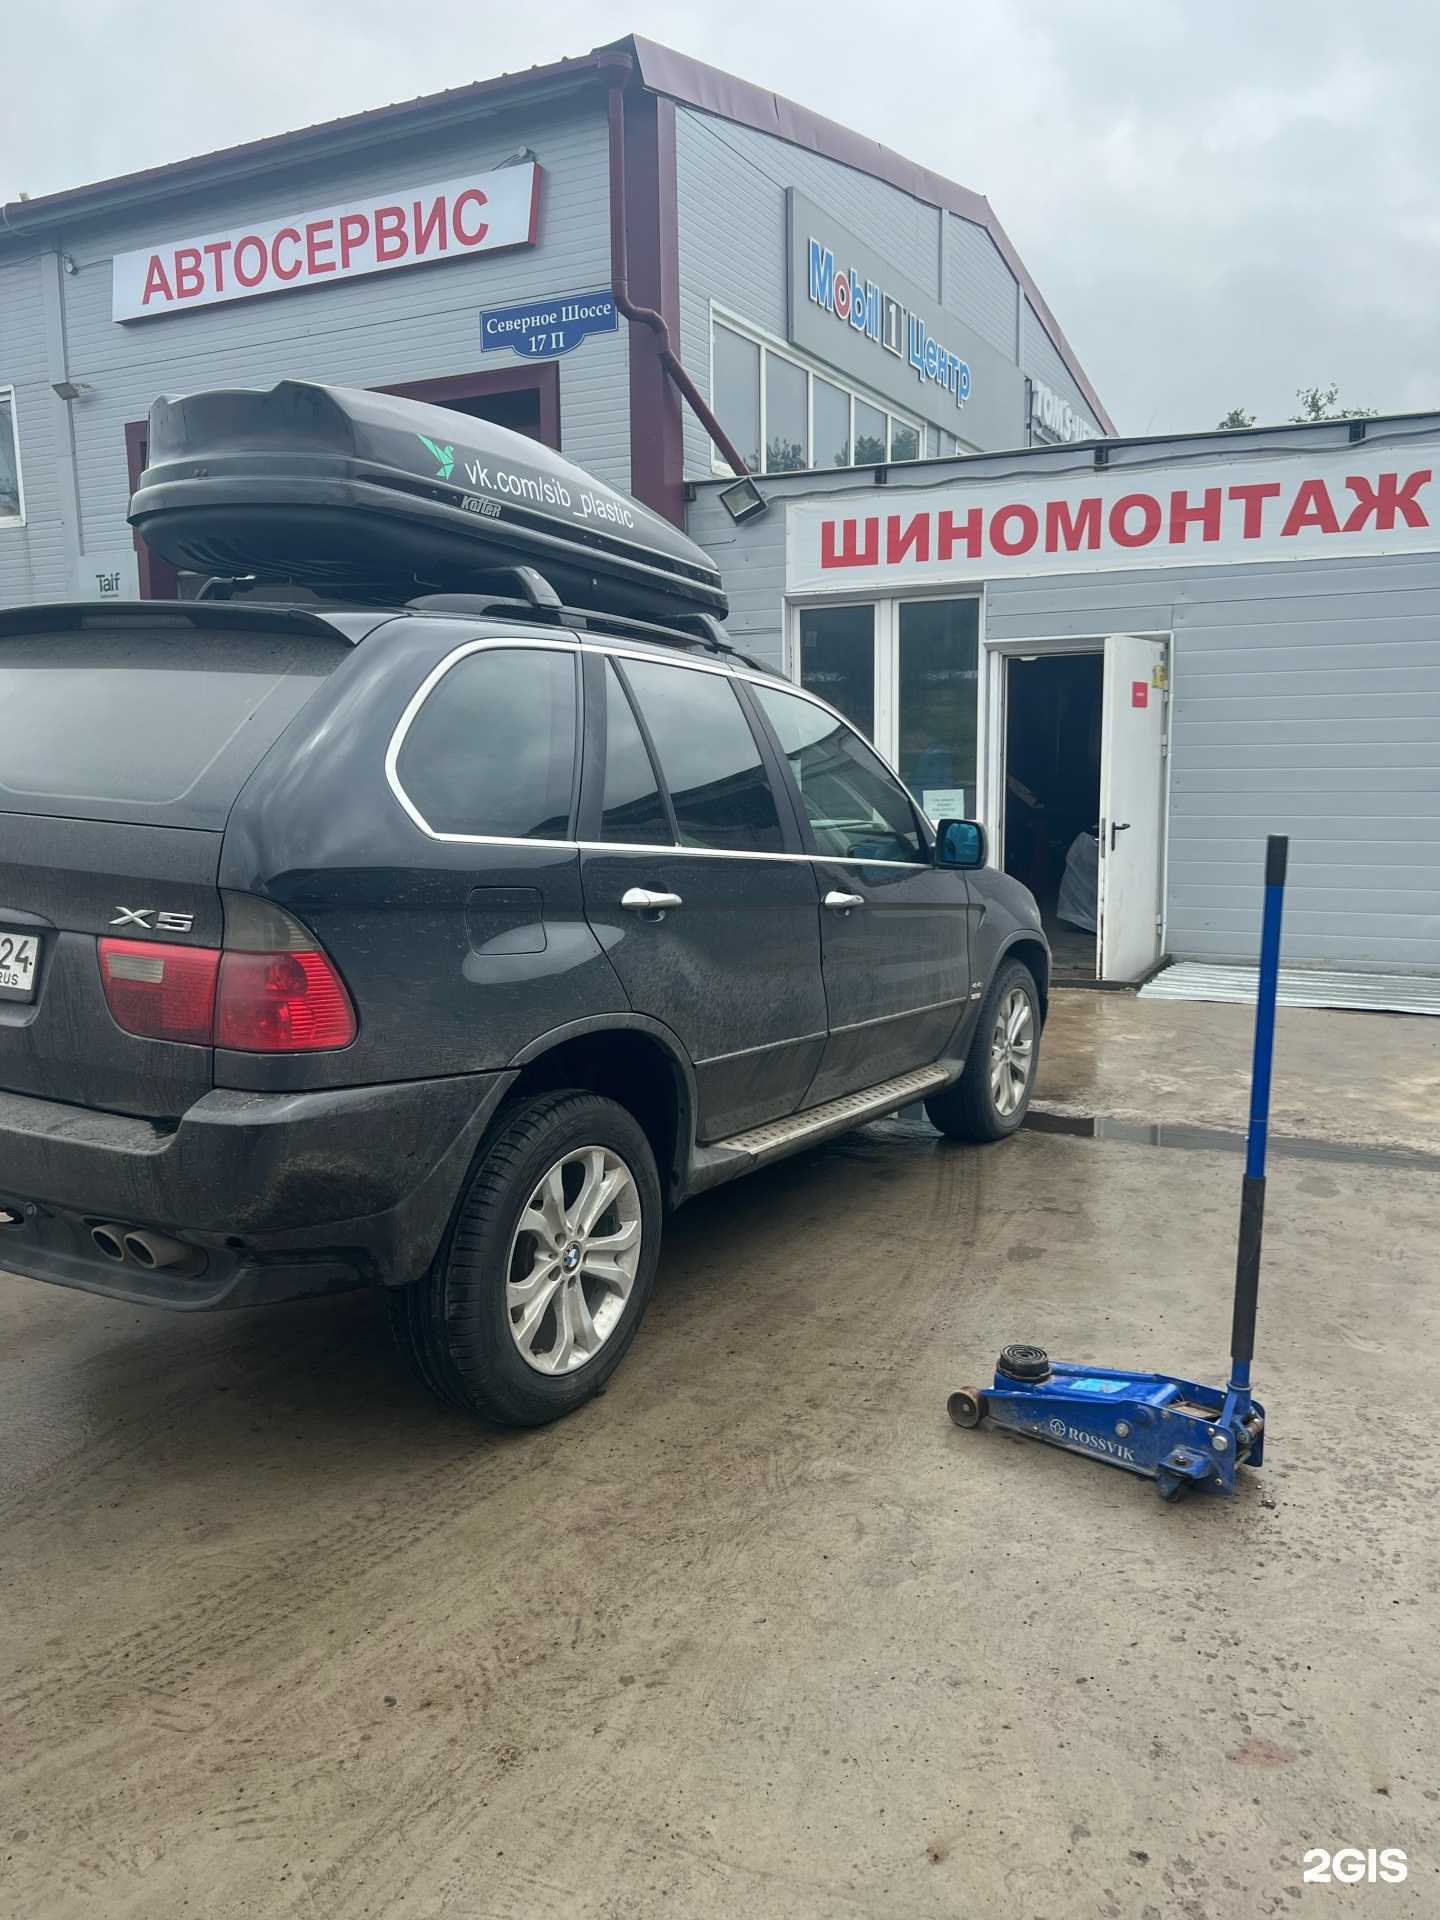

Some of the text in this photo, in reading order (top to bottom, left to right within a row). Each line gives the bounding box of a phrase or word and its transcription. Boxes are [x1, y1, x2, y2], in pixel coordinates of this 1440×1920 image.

[141, 188, 490, 305] АВТОСЕРВИС
[486, 303, 612, 334] Северное Шоссе
[809, 236, 880, 343] Mobil
[908, 312, 972, 408] Центр
[528, 331, 565, 353] 17 П
[820, 469, 1433, 569] ШИНОМОНТАЖ
[95, 572, 121, 592] Taif
[108, 906, 195, 933] X5
[0, 937, 30, 974] 24
[1068, 1427, 1135, 1461] ROSSVIK
